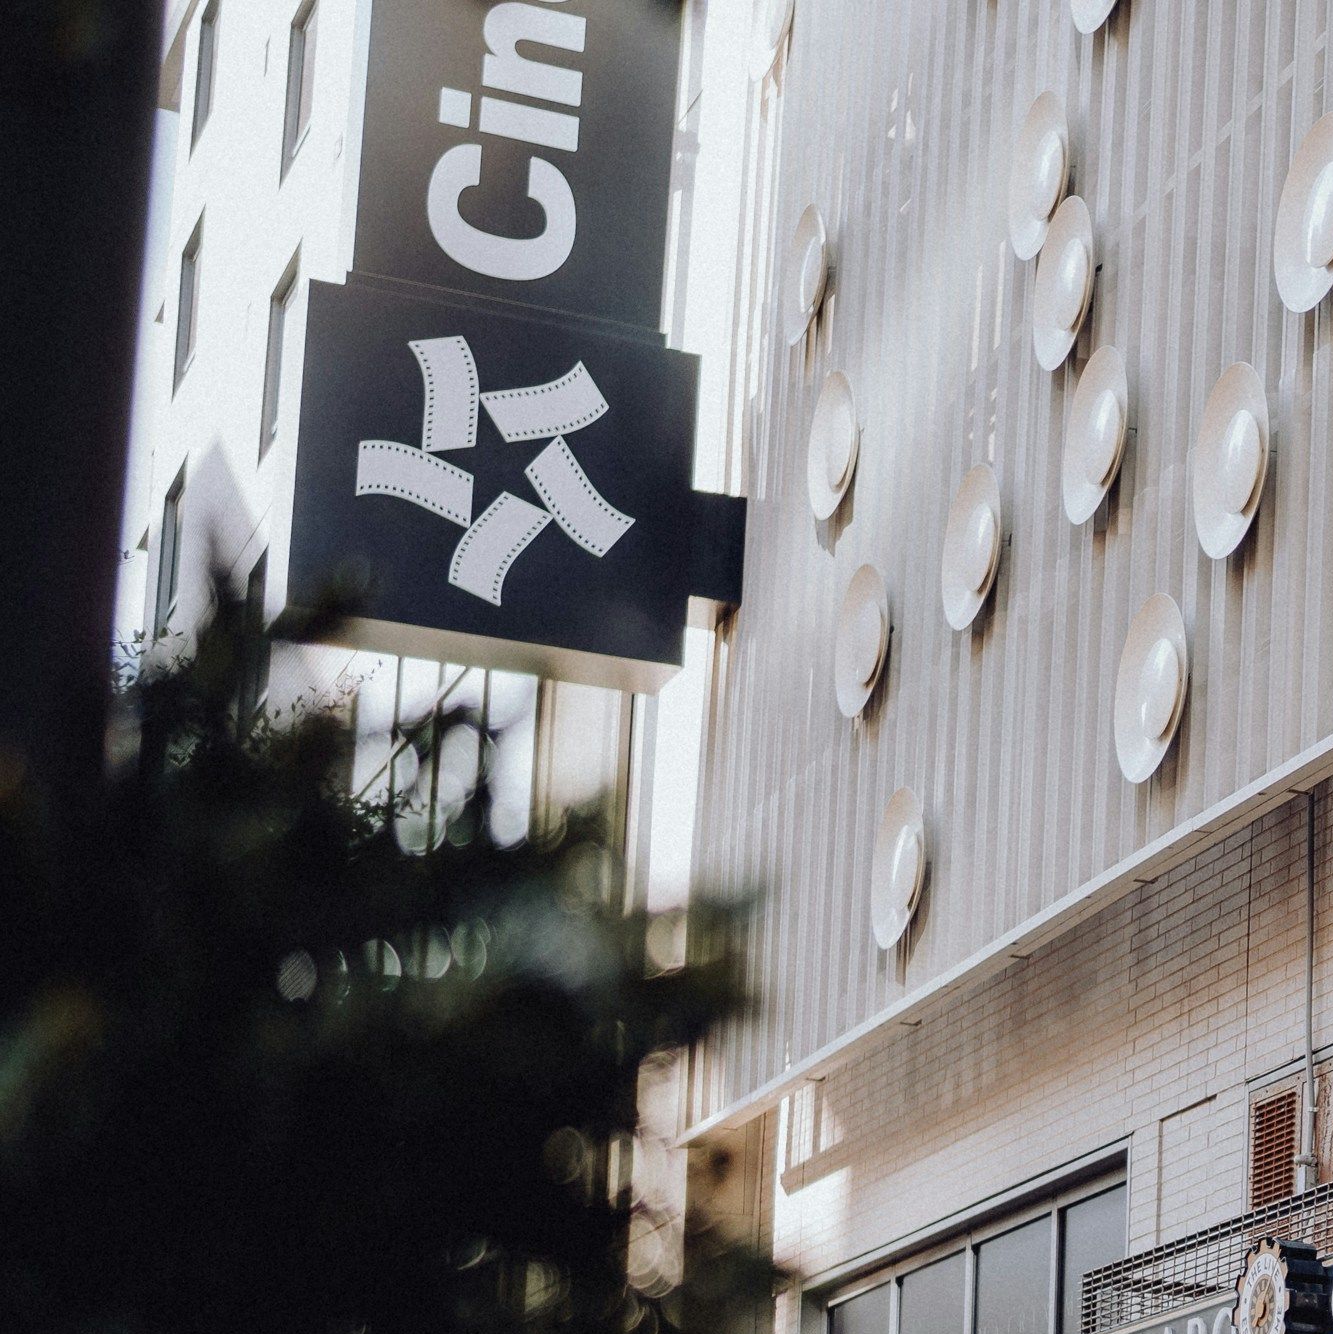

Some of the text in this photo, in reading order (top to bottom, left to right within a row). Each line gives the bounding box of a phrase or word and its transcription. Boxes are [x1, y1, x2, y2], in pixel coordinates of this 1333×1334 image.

[427, 0, 587, 281] Cin
[1247, 1256, 1280, 1288] THE LIVE
